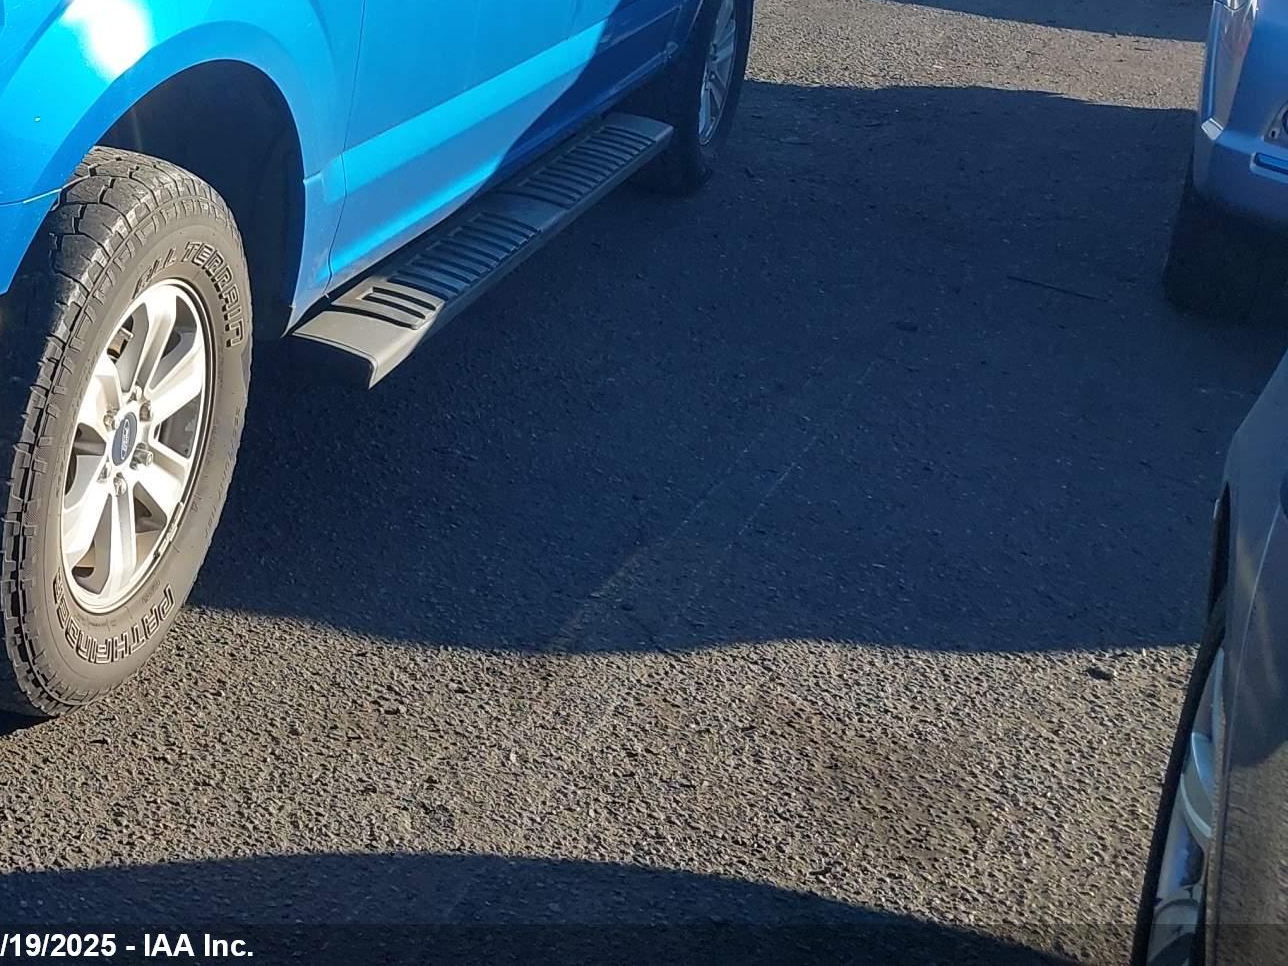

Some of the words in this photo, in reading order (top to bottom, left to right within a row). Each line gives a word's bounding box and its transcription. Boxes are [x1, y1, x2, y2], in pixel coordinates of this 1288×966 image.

[132, 247, 176, 299] ALL
[181, 241, 244, 347] TERRAIN
[52, 567, 175, 665] PATHFINDER
